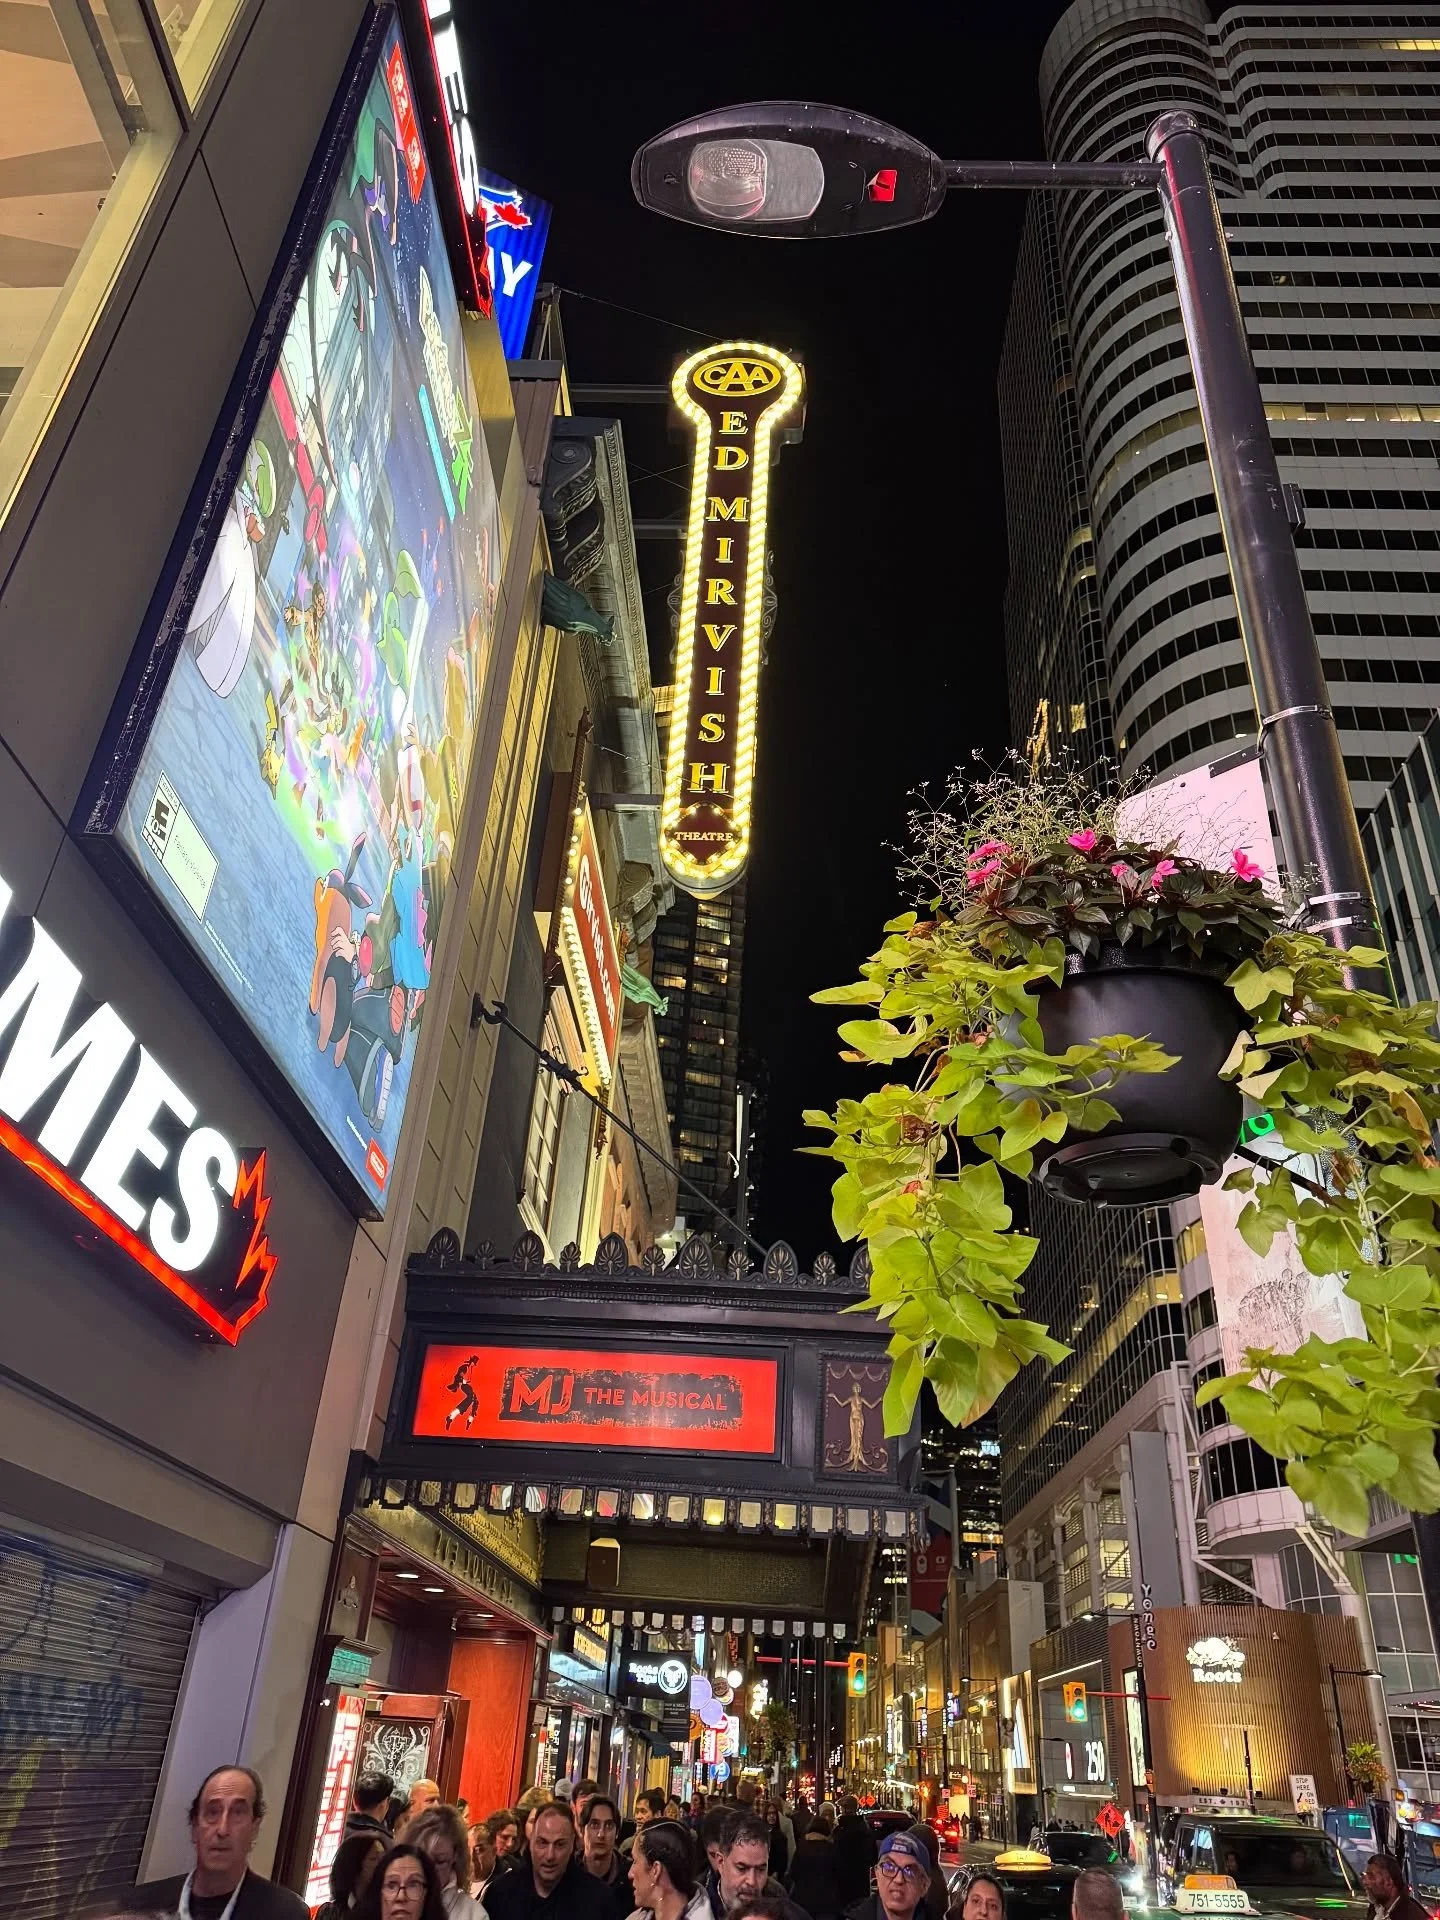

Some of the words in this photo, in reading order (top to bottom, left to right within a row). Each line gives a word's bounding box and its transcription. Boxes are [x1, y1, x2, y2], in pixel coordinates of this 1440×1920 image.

[703, 361, 769, 391] CAA
[713, 411, 749, 471] ED
[686, 496, 750, 794] MIRVISH
[674, 831, 733, 841] THEATRE
[0, 873, 239, 1272] MES
[510, 1372, 575, 1416] MJ
[584, 1387, 625, 1407] THE
[632, 1390, 727, 1412] MUSICAL
[1132, 1617, 1144, 1668] DOWNTOWN
[1192, 1667, 1242, 1684] Roots
[1085, 1740, 1105, 1782] 250
[1188, 1893, 1246, 1909] 751-5555
